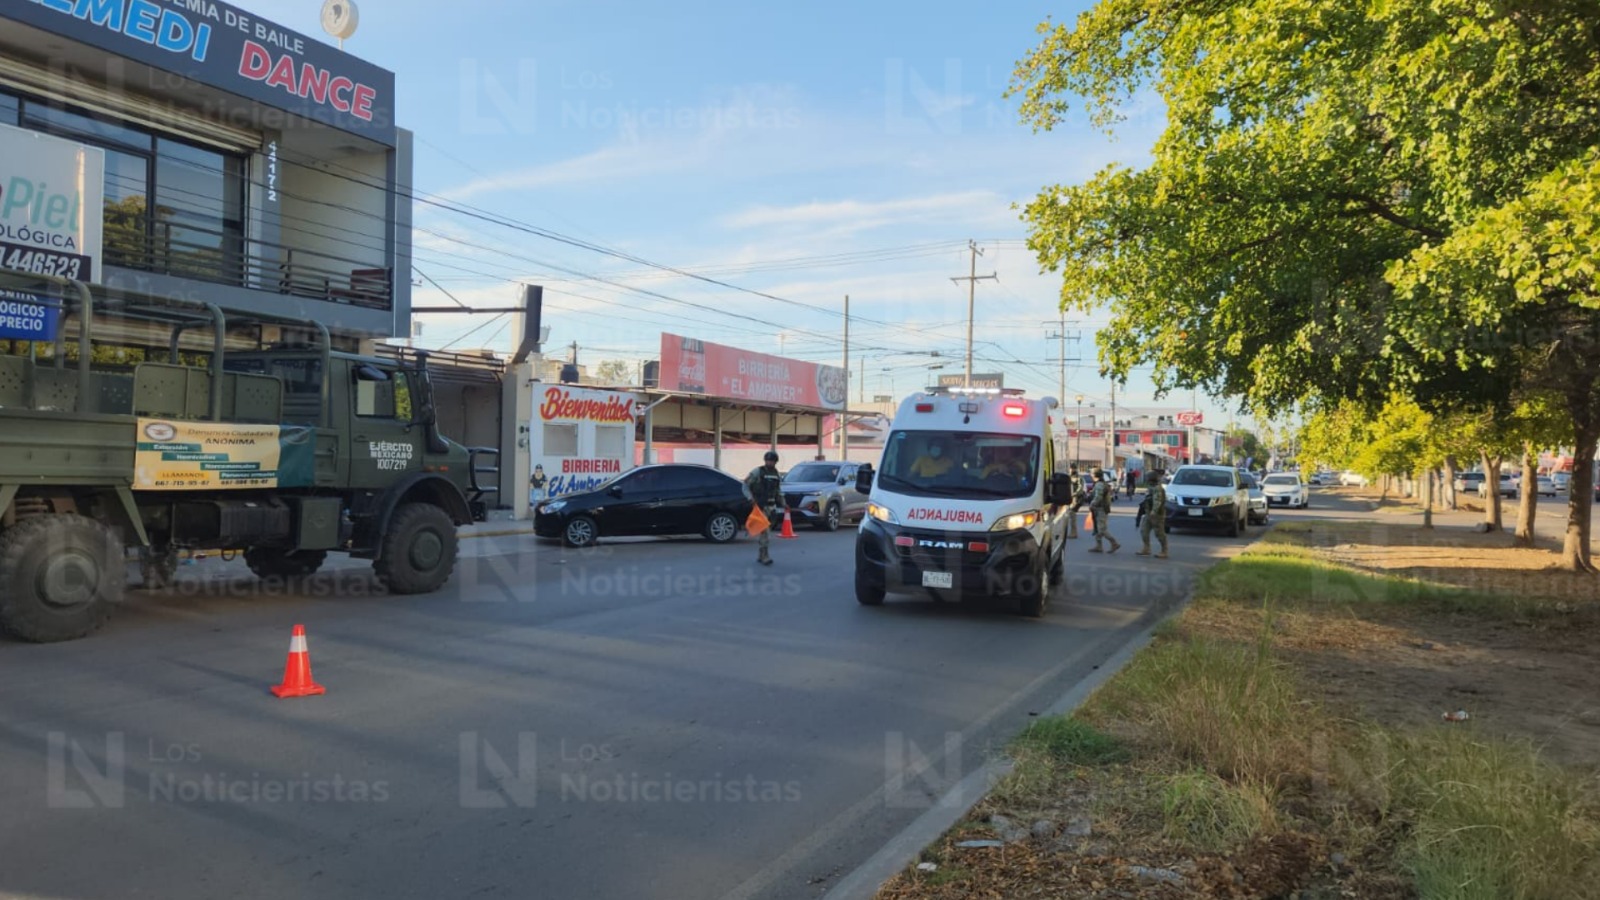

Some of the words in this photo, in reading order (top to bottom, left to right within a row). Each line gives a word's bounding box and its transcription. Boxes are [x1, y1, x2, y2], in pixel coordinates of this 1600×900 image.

[225, 10, 249, 33] DE
[255, 23, 304, 55] BAILE
[238, 40, 376, 121] DANCE
[0, 315, 43, 331] PRECIO
[731, 378, 745, 395] EL
[748, 380, 796, 401] AMPAYER
[540, 387, 635, 424] Bienvenidos
[369, 440, 413, 452] EJÉRCITO
[370, 451, 413, 459] MEXICANO
[377, 458, 407, 470] 1007219
[562, 459, 621, 474] BIRRIERIA
[548, 475, 565, 497] El
[919, 540, 964, 549] RAM
